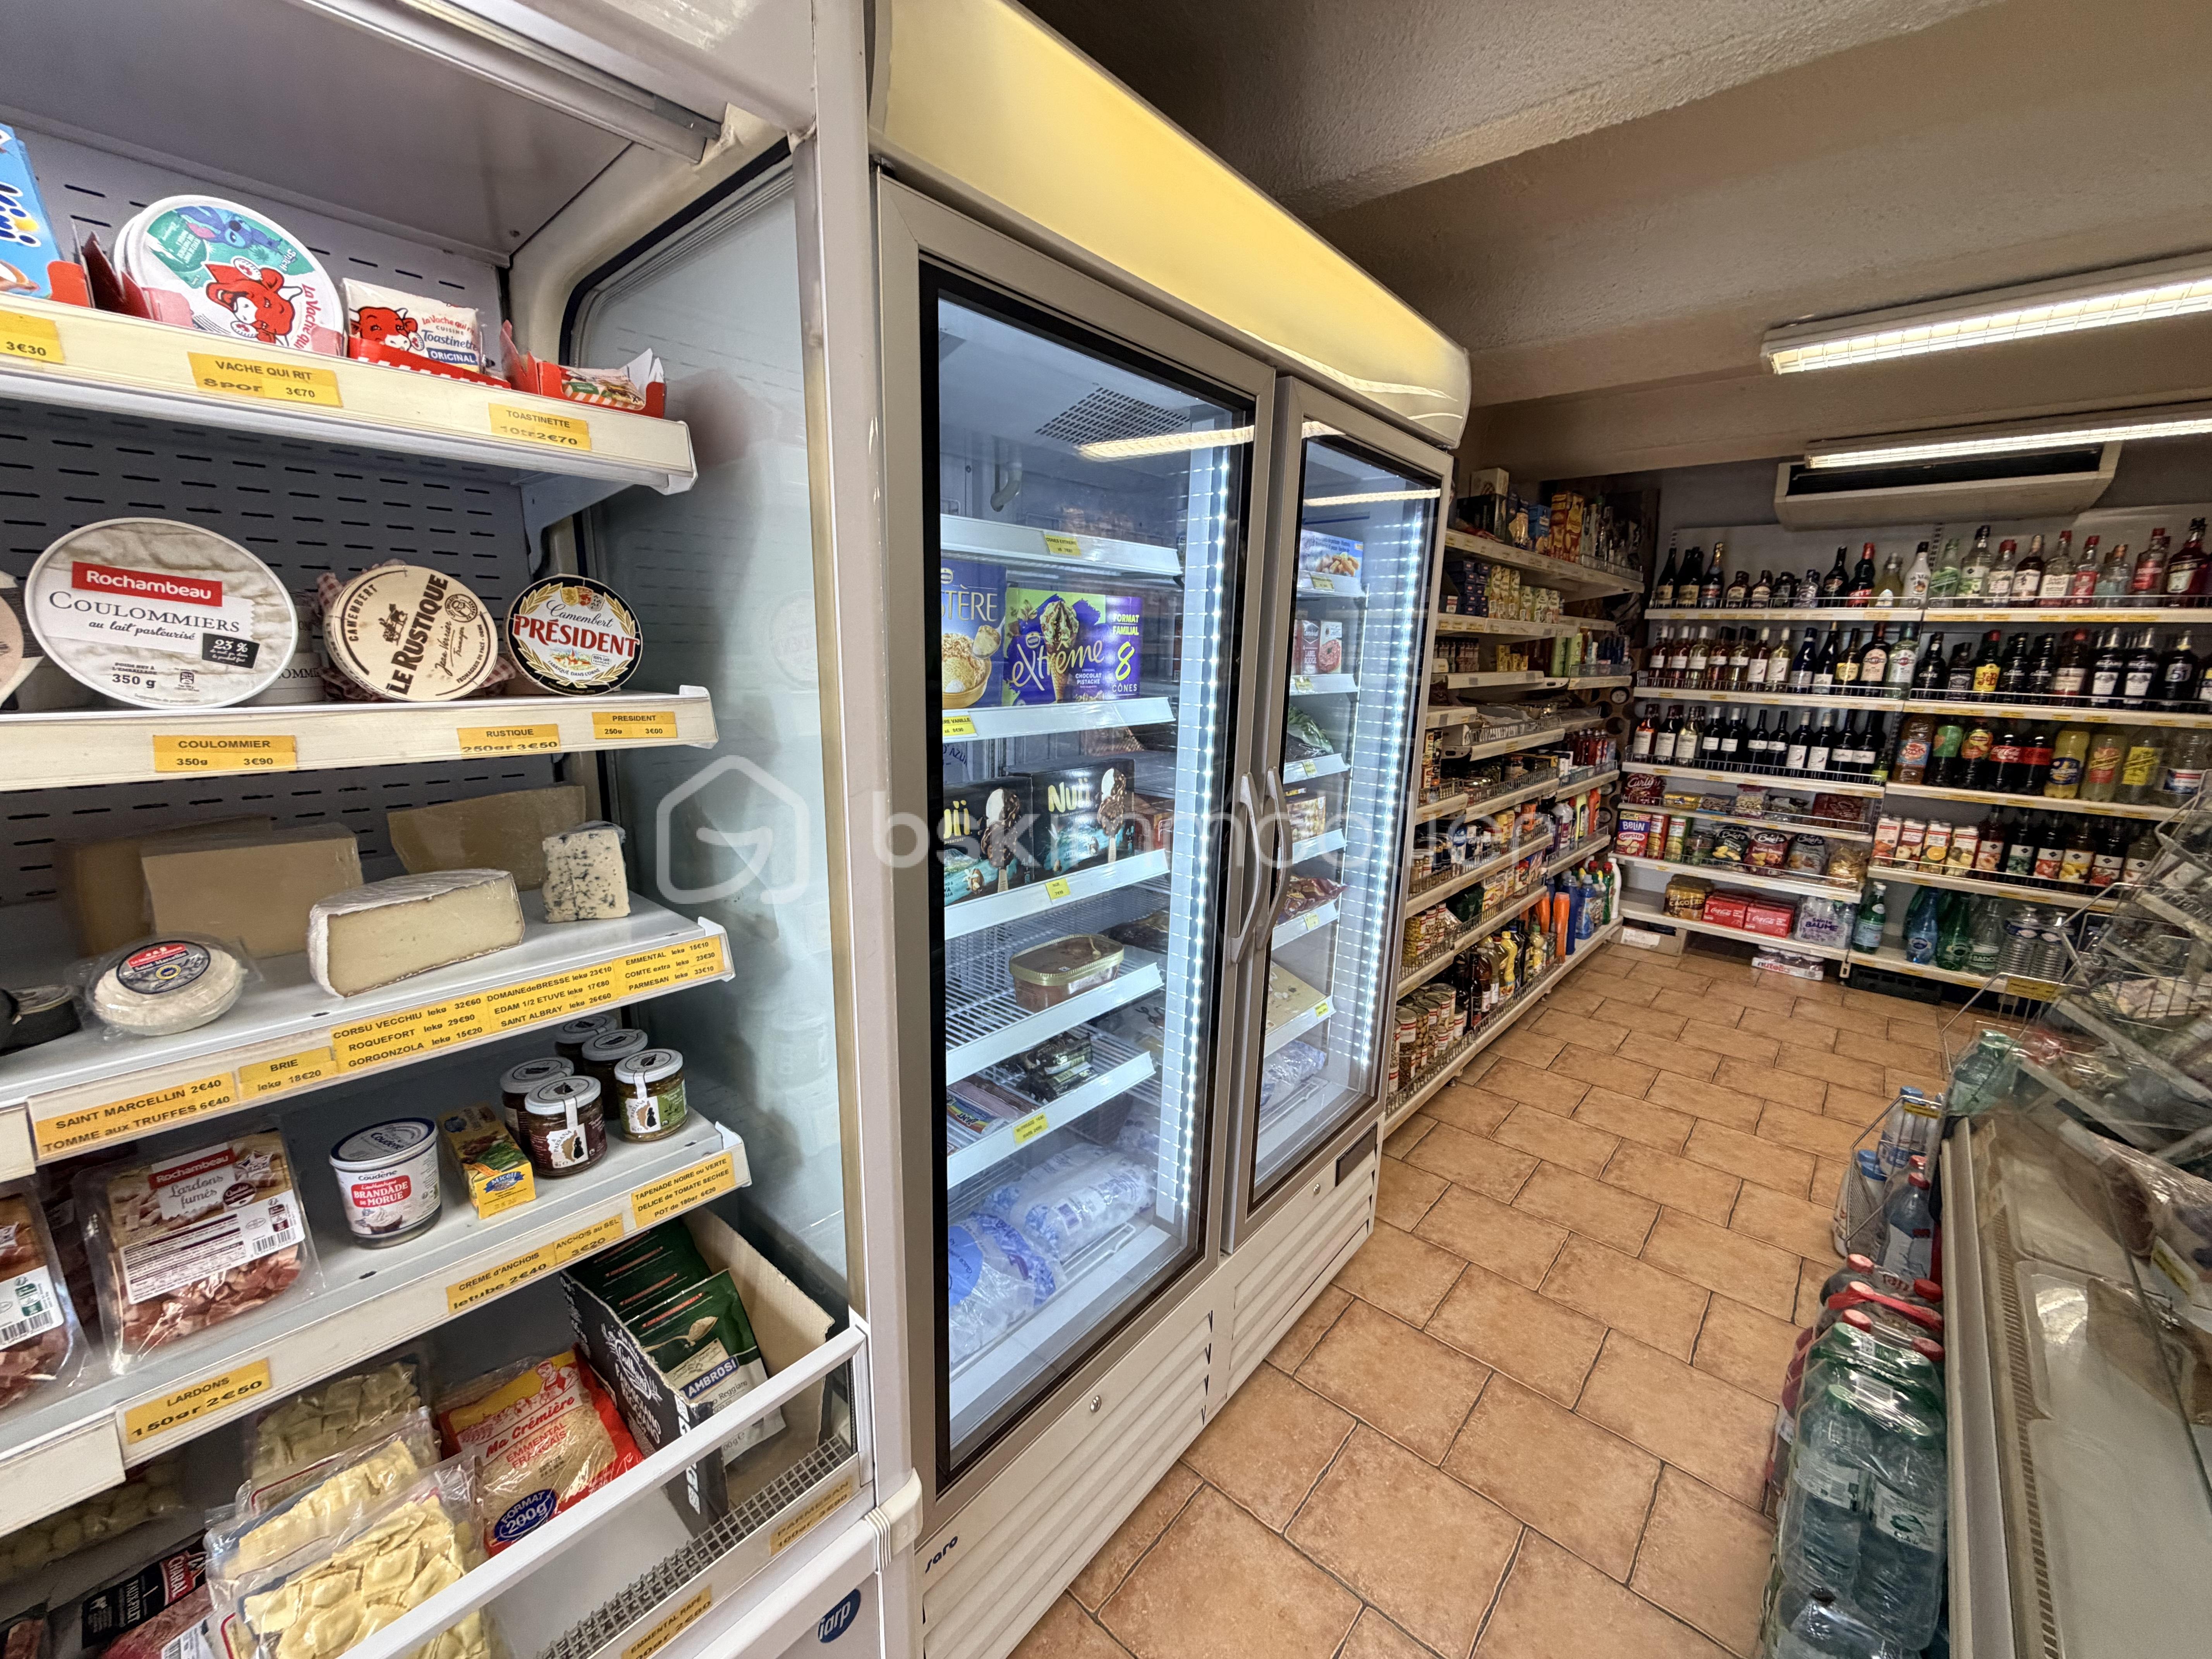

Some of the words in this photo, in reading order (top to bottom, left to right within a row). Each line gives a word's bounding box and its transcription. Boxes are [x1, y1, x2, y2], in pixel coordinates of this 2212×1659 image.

[302, 283, 315, 299] La
[302, 299, 321, 333] Vache
[429, 314, 453, 325] Vache
[455, 321, 467, 330] qui
[436, 325, 464, 335] CUISINE
[5, 341, 47, 357] 3€30
[430, 350, 475, 363] ORIGINAL
[215, 361, 263, 374] VACHE
[267, 368, 289, 377] QUI
[293, 370, 312, 380] RIT
[286, 387, 315, 398] 3€70
[506, 410, 571, 429] TOASTINETTE
[537, 432, 577, 445] 2€70
[86, 569, 212, 600] Rochambeau
[48, 591, 240, 633] COULOMMIERS
[347, 584, 378, 642] CAMEMBERT
[391, 573, 448, 672] RUSTIQUE
[546, 599, 614, 628] Camembert
[1113, 613, 1140, 623] FORMAT
[88, 621, 105, 629] au
[110, 620, 133, 633] lait
[134, 627, 196, 641] pasteurisé
[514, 613, 640, 658] PRÉSIDENT
[1112, 625, 1139, 635] FAMILIAL
[237, 642, 249, 653] %
[1115, 641, 1135, 681] 8
[435, 650, 453, 677] Jean
[456, 659, 480, 684] FROMAGERIE
[548, 660, 570, 675] FABRIQUÉ
[584, 668, 600, 677] L'ORNE
[112, 674, 140, 685] 350
[146, 680, 156, 689] g
[385, 669, 414, 696] LE
[1112, 683, 1137, 693] CÔNES
[178, 740, 271, 749] COULOMMIER
[486, 728, 534, 737] RUSTIQUE
[517, 741, 558, 750] 3€50
[176, 757, 208, 767] 350g
[243, 757, 273, 766] 3€90
[1627, 776, 1654, 789] Curly
[625, 951, 666, 966] EMMENTAL
[689, 941, 709, 951] 15€10
[625, 968, 652, 979] COMTE
[653, 963, 671, 973] extra
[696, 952, 715, 962] 23€30
[487, 976, 570, 1002] DOMAINEdeBRESSE
[589, 966, 612, 977] 23€10
[629, 976, 669, 991] PARMESAN
[694, 966, 714, 975] 33€10
[494, 1003, 520, 1015] EDAM
[522, 999, 536, 1008] 1/2
[537, 991, 566, 1004] ETUVE
[587, 980, 610, 991] 17€80
[501, 1016, 527, 1027] SAINT
[529, 1005, 563, 1020] ALBRAY
[588, 993, 612, 1003] 26€60
[333, 1024, 373, 1039] CORSU
[375, 1012, 422, 1029] VECCHIU
[454, 998, 481, 1010] 32€60
[348, 1029, 416, 1051] ROQUEFORT
[447, 1014, 476, 1027] 29€90
[348, 1042, 424, 1068] GORGONZOLA
[455, 1027, 483, 1039] 15€20
[270, 1059, 299, 1072] BRIE
[288, 1069, 322, 1084] 18€20
[56, 1111, 100, 1129] SAINT
[104, 1089, 186, 1118] MARCELLIN
[190, 1079, 222, 1094] 2€40
[42, 1130, 100, 1152] TOMME
[105, 1124, 131, 1137] aux
[132, 1104, 197, 1128] TRUFFES
[199, 1096, 231, 1110] 6€40
[553, 1130, 572, 1152] PAESANA
[156, 1155, 228, 1182] Rochambeau
[635, 1179, 674, 1200] TAPENADE
[673, 1171, 695, 1185] NOIRE
[704, 1158, 728, 1172] VERTE
[168, 1174, 223, 1199] Lardons
[181, 1188, 217, 1209] fumés
[368, 1192, 404, 1206] MORUE
[638, 1198, 664, 1212] DELICE
[665, 1193, 674, 1201] de
[674, 1181, 702, 1197] TOMATE
[702, 1169, 730, 1184] SECHEE
[654, 1207, 669, 1218] POT
[700, 1186, 716, 1199] 6€20
[555, 1228, 592, 1250] ANCHOIS
[593, 1224, 603, 1233] au
[603, 1218, 619, 1229] SEL
[571, 1237, 606, 1257] 3€20
[458, 1270, 493, 1291] CREME
[493, 1252, 540, 1277] d'ANCHOIS
[509, 1262, 548, 1285] 2€40
[166, 1376, 230, 1407] LARDONS
[689, 1358, 737, 1398] AMBROSI
[718, 1380, 748, 1401] Reggiano
[206, 1379, 263, 1408] 2€50
[485, 1437, 509, 1458] Ma
[511, 1395, 575, 1440] Crémière
[506, 1421, 567, 1463] EMMENTAL
[501, 1491, 546, 1524] FORMAT
[506, 1501, 548, 1534] 200g
[776, 1480, 850, 1537] PARMESAN
[818, 1493, 848, 1519] 3€90
[925, 1535, 958, 1574] saro
[168, 1555, 189, 1598] CHARAL
[631, 1615, 678, 1654] EMMENTAL
[680, 1595, 702, 1616] RAPE
[817, 1600, 851, 1640] iarp
